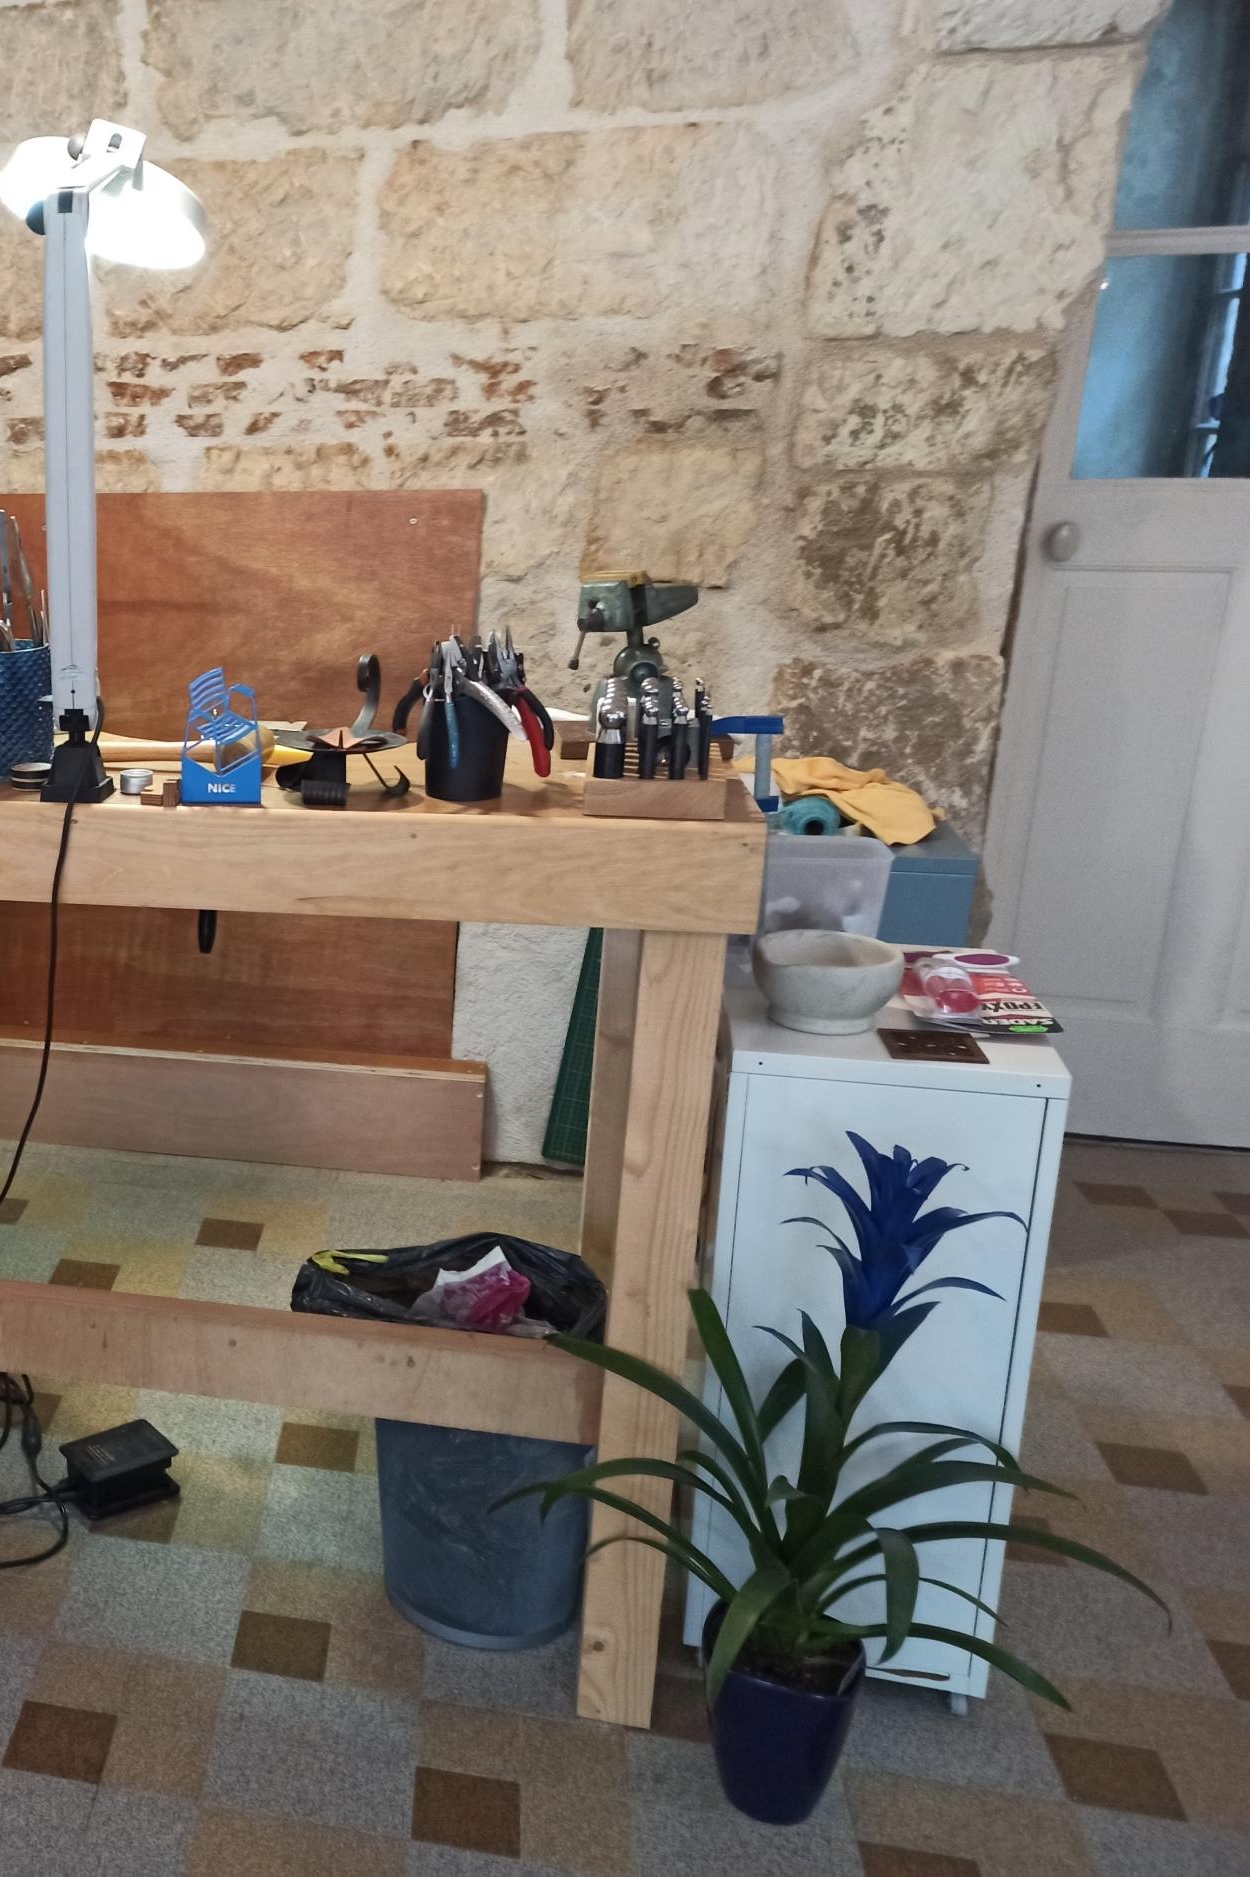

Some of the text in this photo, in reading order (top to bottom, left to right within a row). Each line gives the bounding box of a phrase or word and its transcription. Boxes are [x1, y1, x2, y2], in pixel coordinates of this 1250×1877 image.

[208, 783, 236, 793] NICE
[981, 1001, 1042, 1012] EPOXY
[982, 1017, 1054, 1025] SADER
